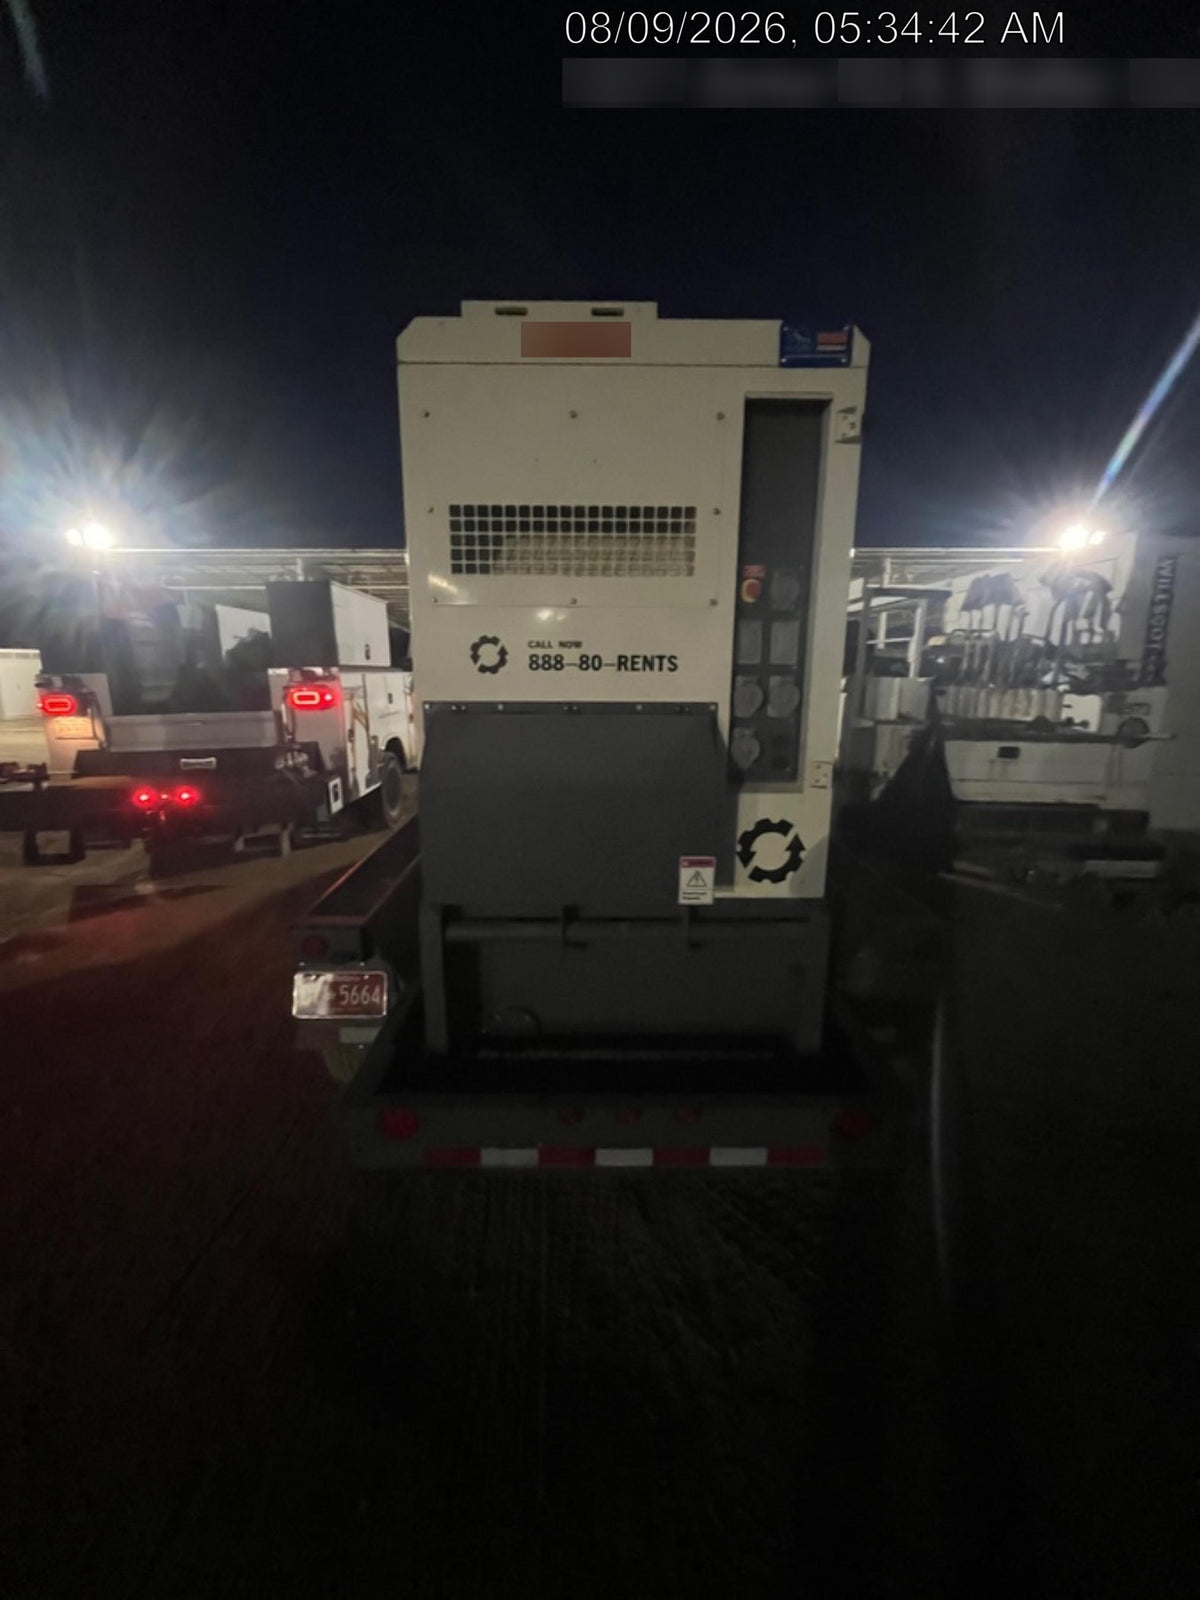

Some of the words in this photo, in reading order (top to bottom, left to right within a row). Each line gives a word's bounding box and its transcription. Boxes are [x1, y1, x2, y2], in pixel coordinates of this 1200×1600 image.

[527, 640, 553, 649] CALL
[558, 640, 583, 649] NOW
[528, 654, 679, 672] 888-80-RENTS
